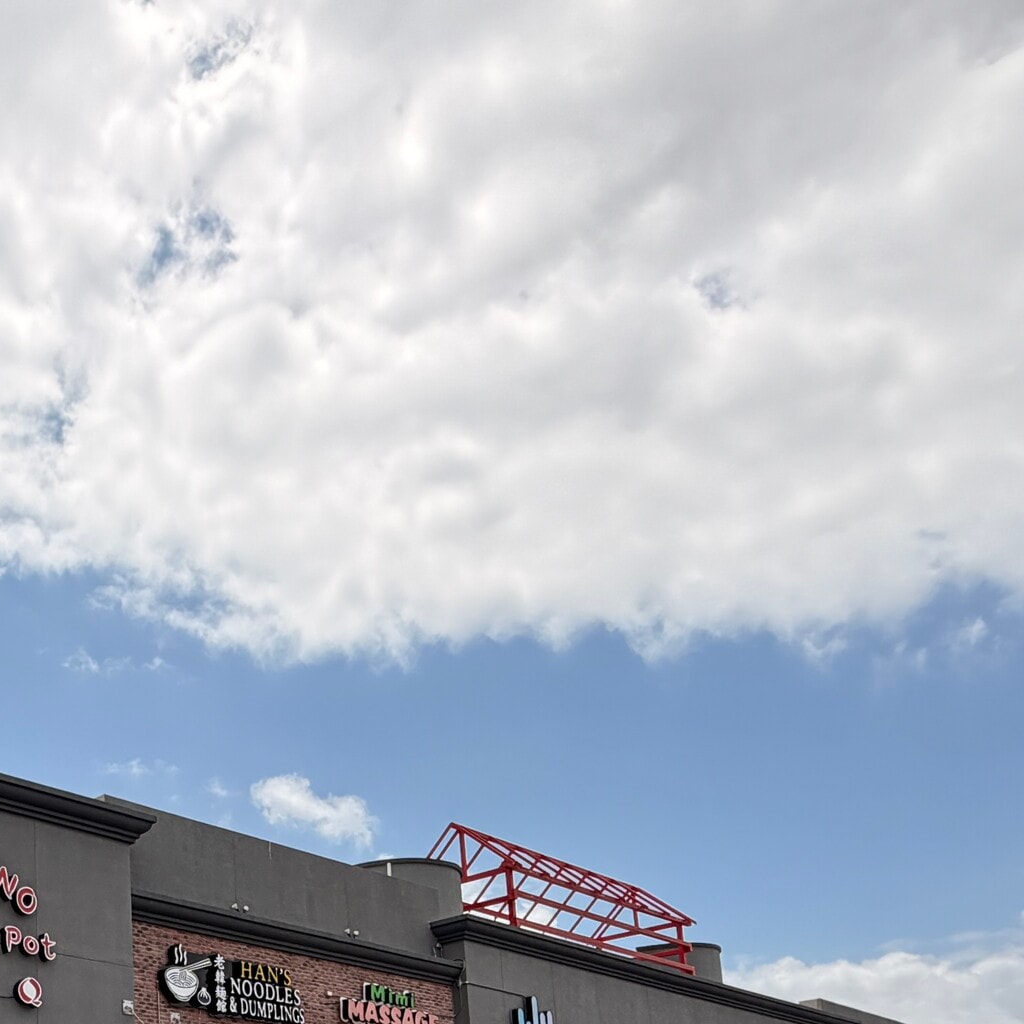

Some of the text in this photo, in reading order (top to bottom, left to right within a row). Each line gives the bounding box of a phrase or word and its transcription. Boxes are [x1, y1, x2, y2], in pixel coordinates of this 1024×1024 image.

[4, 924, 57, 961] Pot
[240, 960, 292, 986] HAN'S
[229, 976, 301, 1006] NOODLES
[229, 1002, 238, 1014] &
